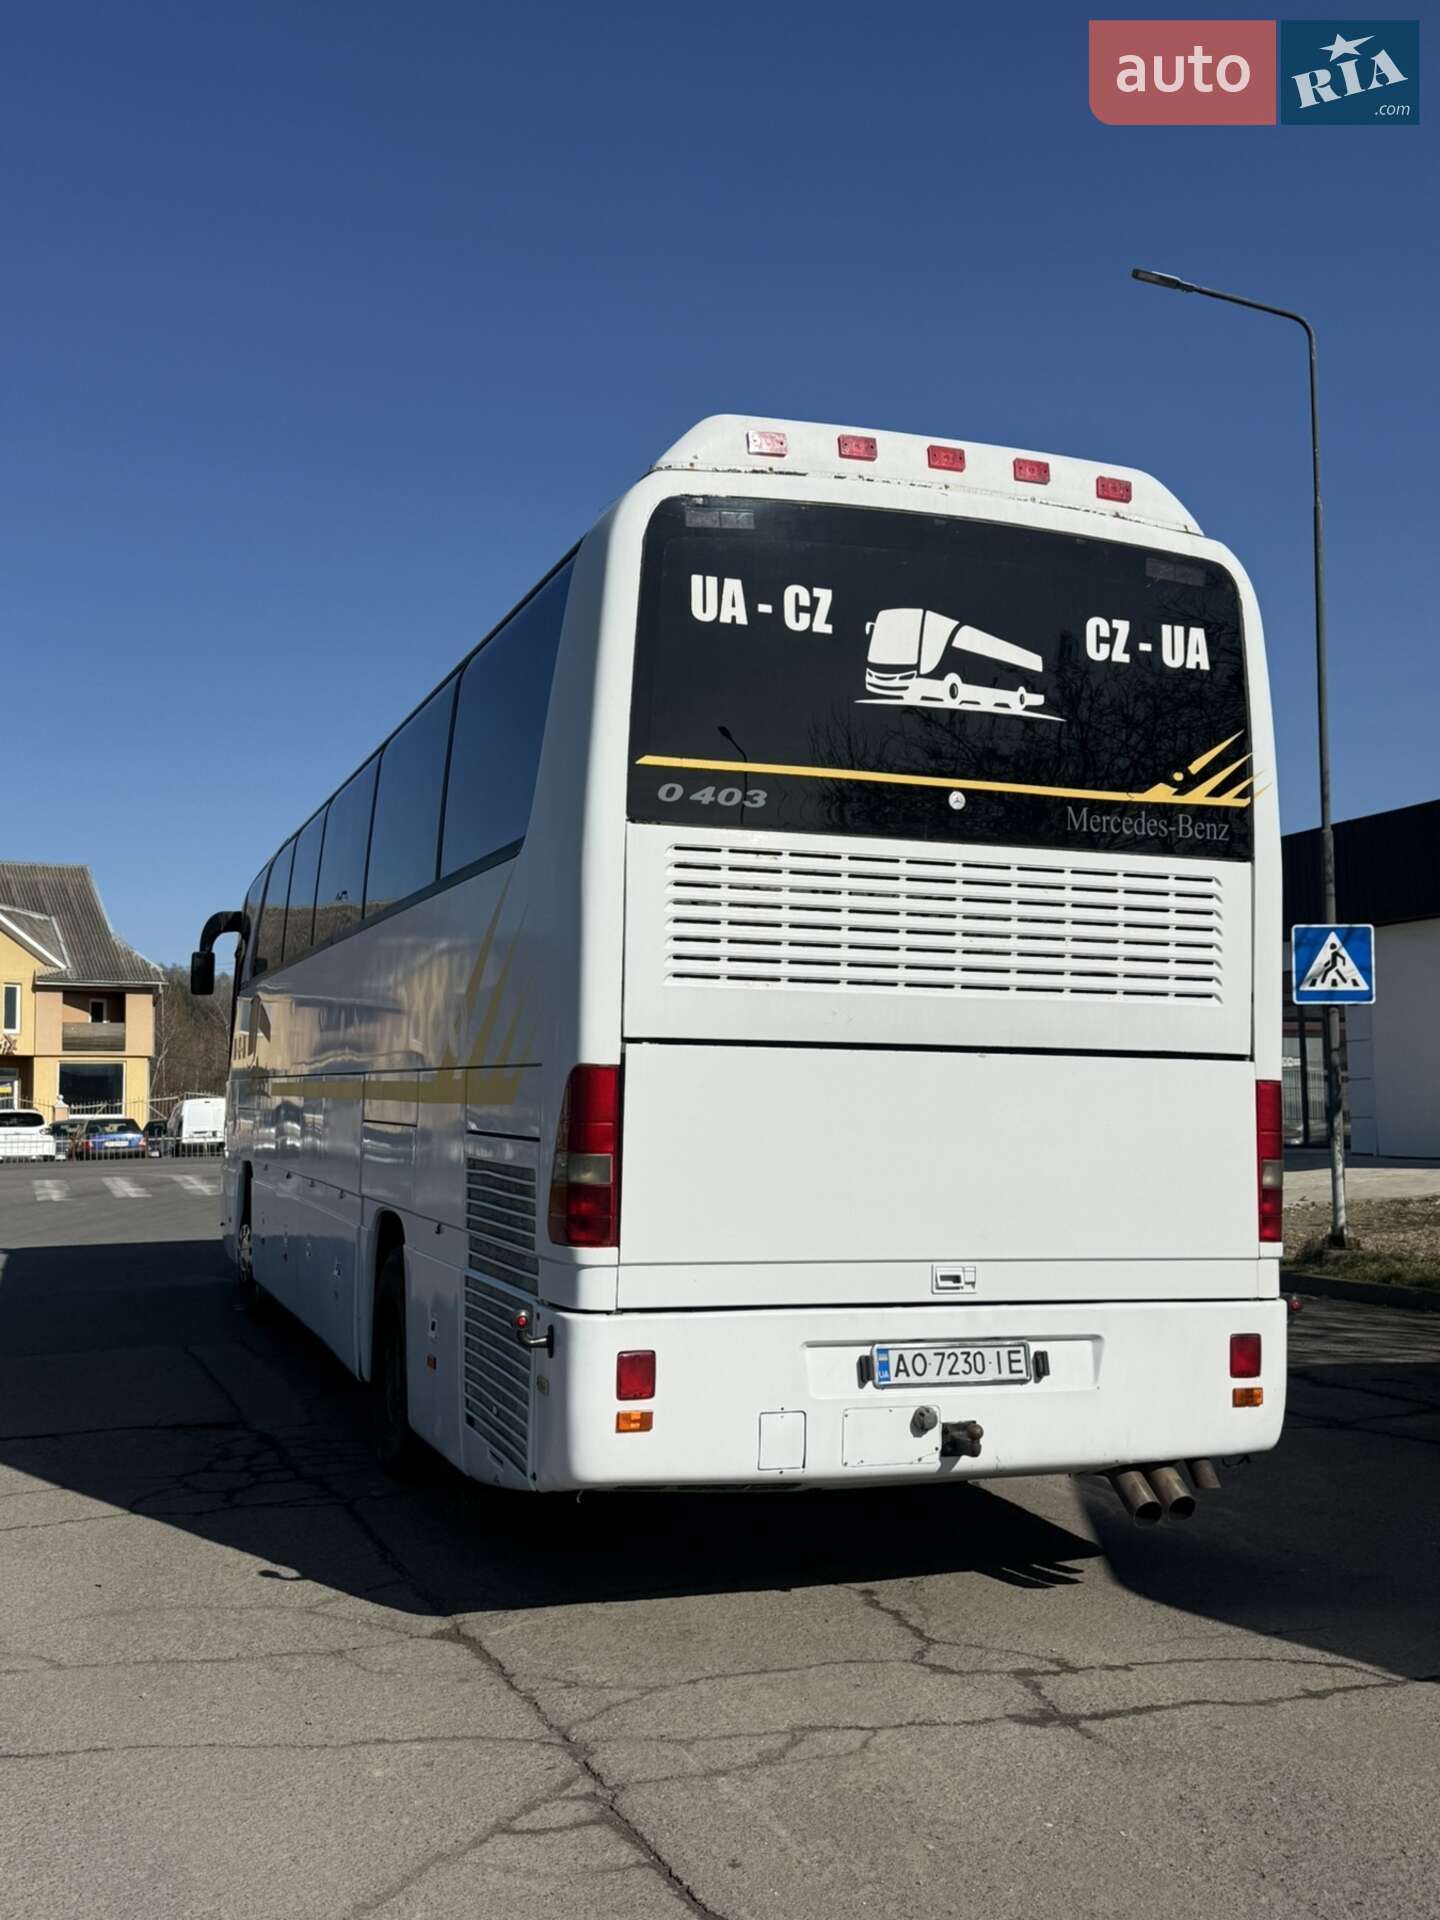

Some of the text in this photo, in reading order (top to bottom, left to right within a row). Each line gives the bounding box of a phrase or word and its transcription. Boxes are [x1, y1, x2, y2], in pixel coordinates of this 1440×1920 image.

[690, 573, 749, 626] UA
[783, 584, 833, 634] CZ
[1085, 616, 1131, 664] CZ
[1161, 623, 1210, 671] UA
[689, 786, 768, 808] 403
[1066, 805, 1230, 841] Mercedes-Benz
[933, 1350, 986, 1377] 7230
